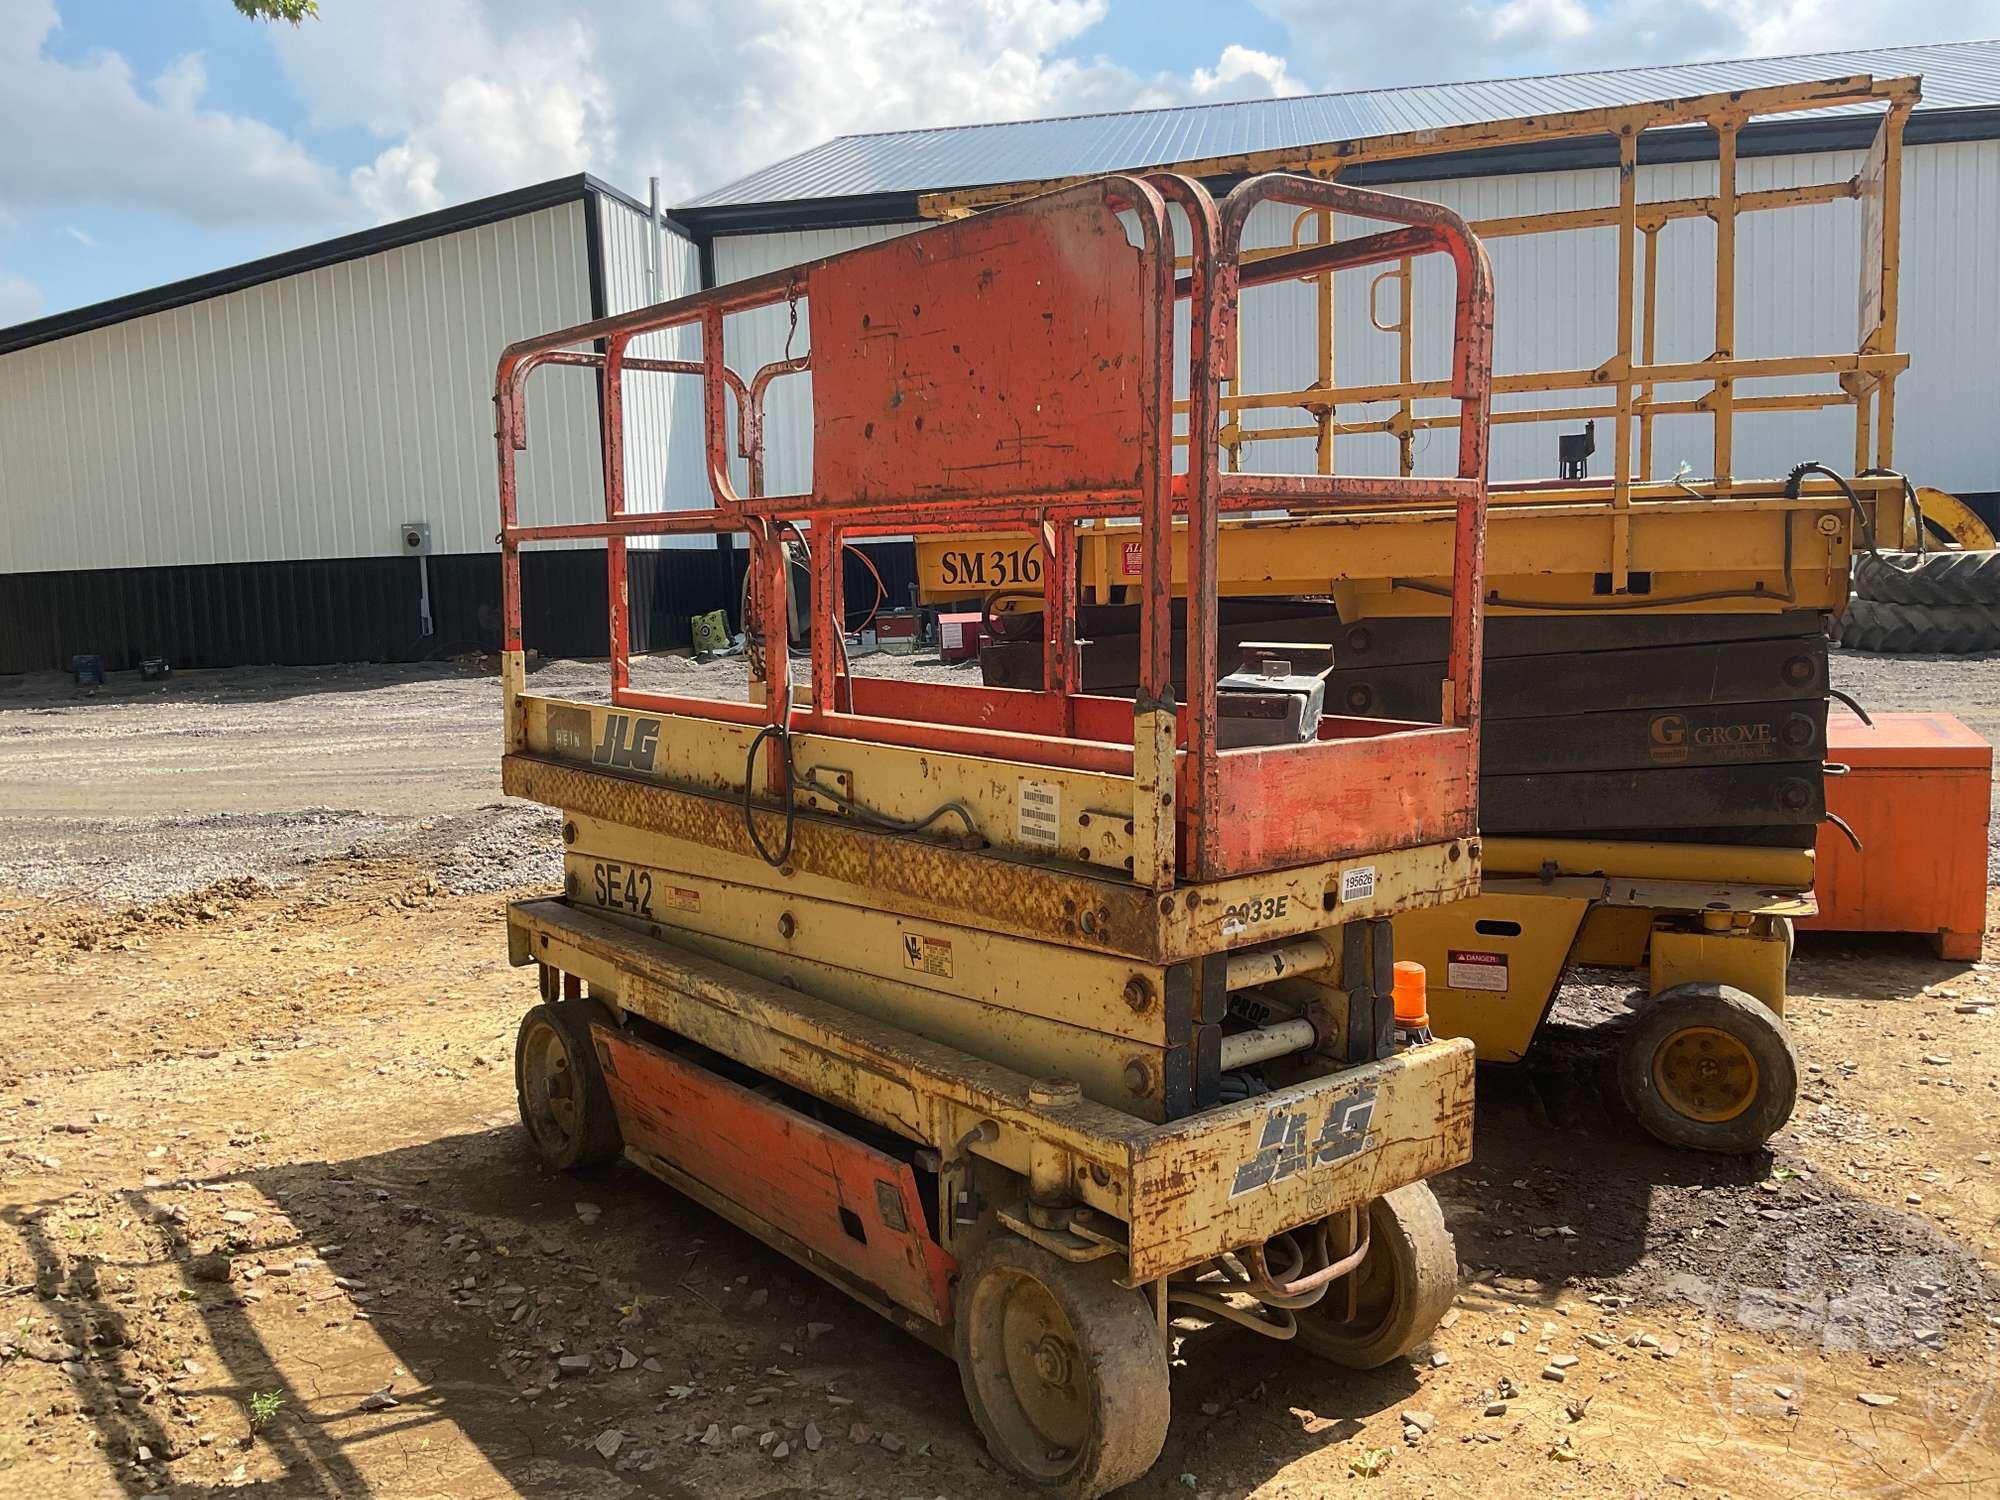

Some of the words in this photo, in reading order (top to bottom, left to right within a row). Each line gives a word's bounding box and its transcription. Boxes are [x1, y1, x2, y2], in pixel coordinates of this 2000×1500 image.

[592, 713, 662, 774] JLG
[1695, 724, 1772, 745] GROVE
[594, 863, 654, 916] SE42
[1346, 873, 1373, 889] 195626
[1466, 954, 1496, 963] DANGER
